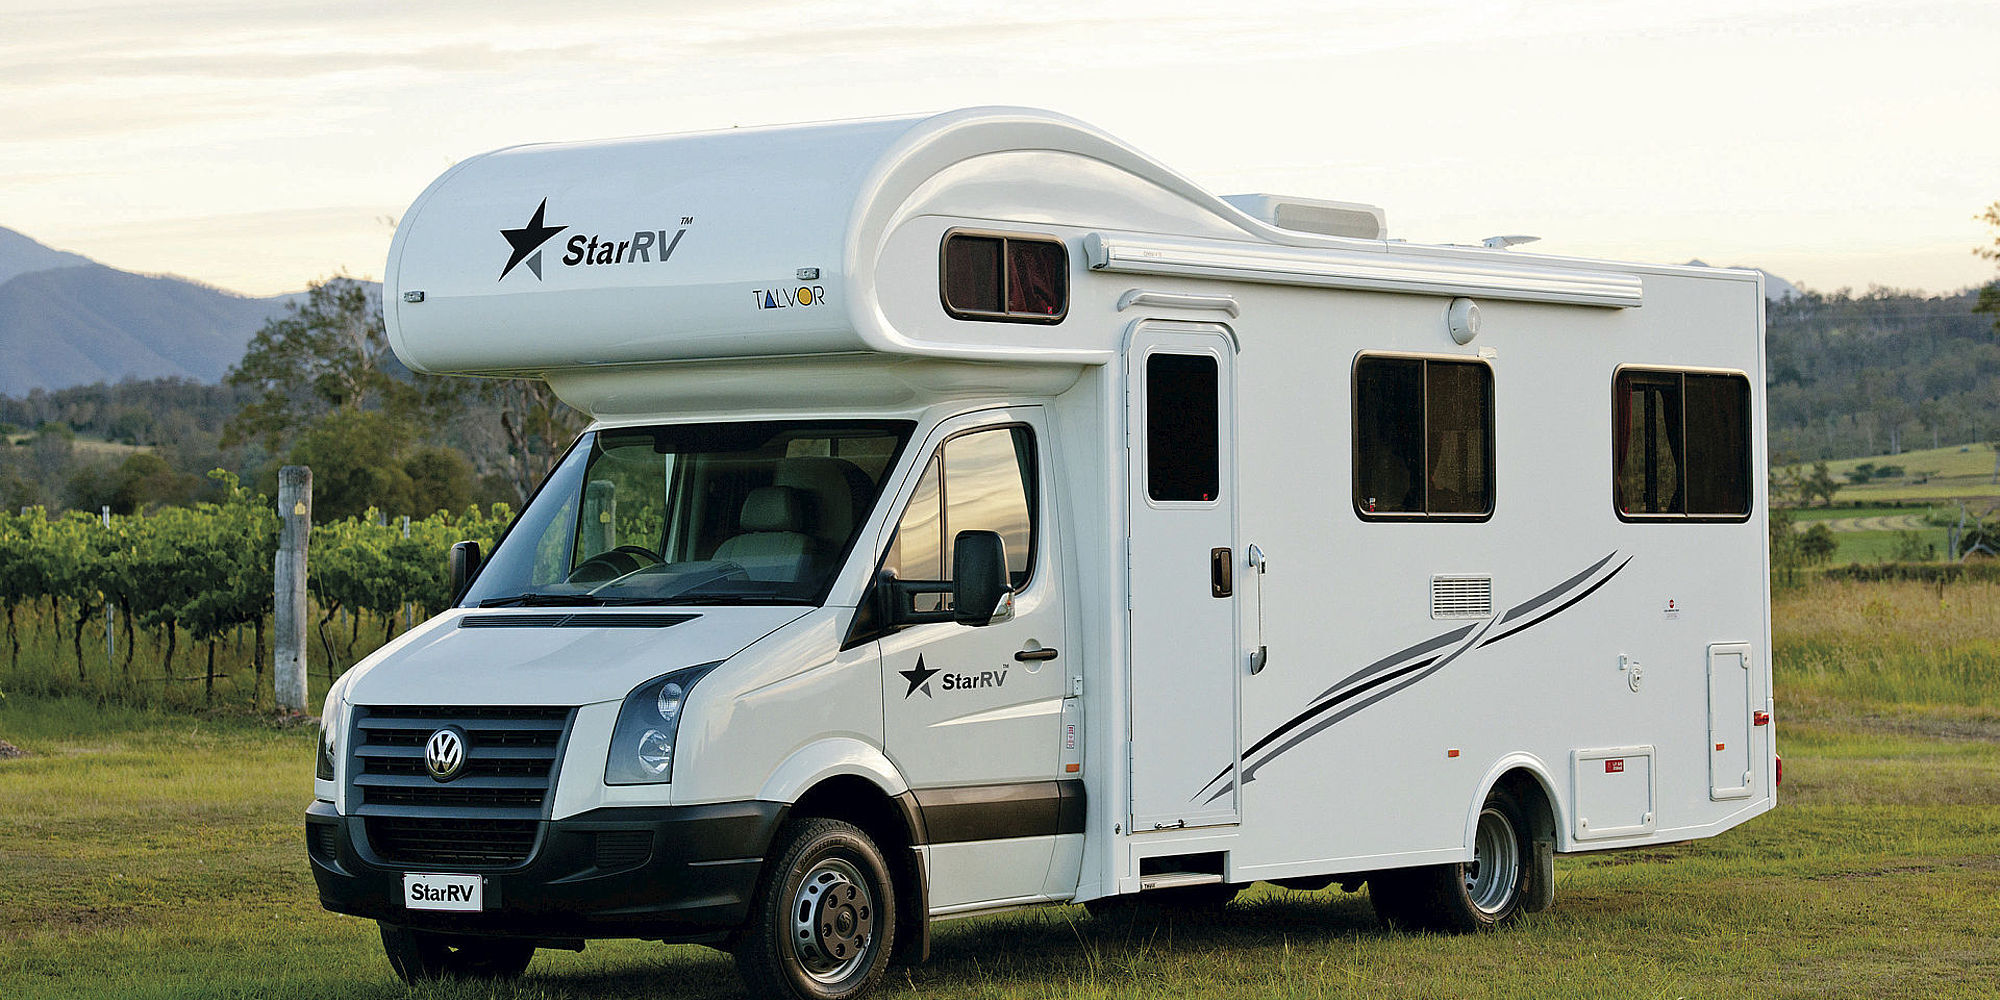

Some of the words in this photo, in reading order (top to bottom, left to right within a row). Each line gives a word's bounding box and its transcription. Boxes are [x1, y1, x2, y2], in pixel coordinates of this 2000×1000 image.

[562, 228, 687, 266] StarRV
[752, 285, 825, 310] TALVOR
[942, 670, 1008, 690] StarRV
[427, 730, 462, 776] VW
[411, 882, 474, 902] StarRV
